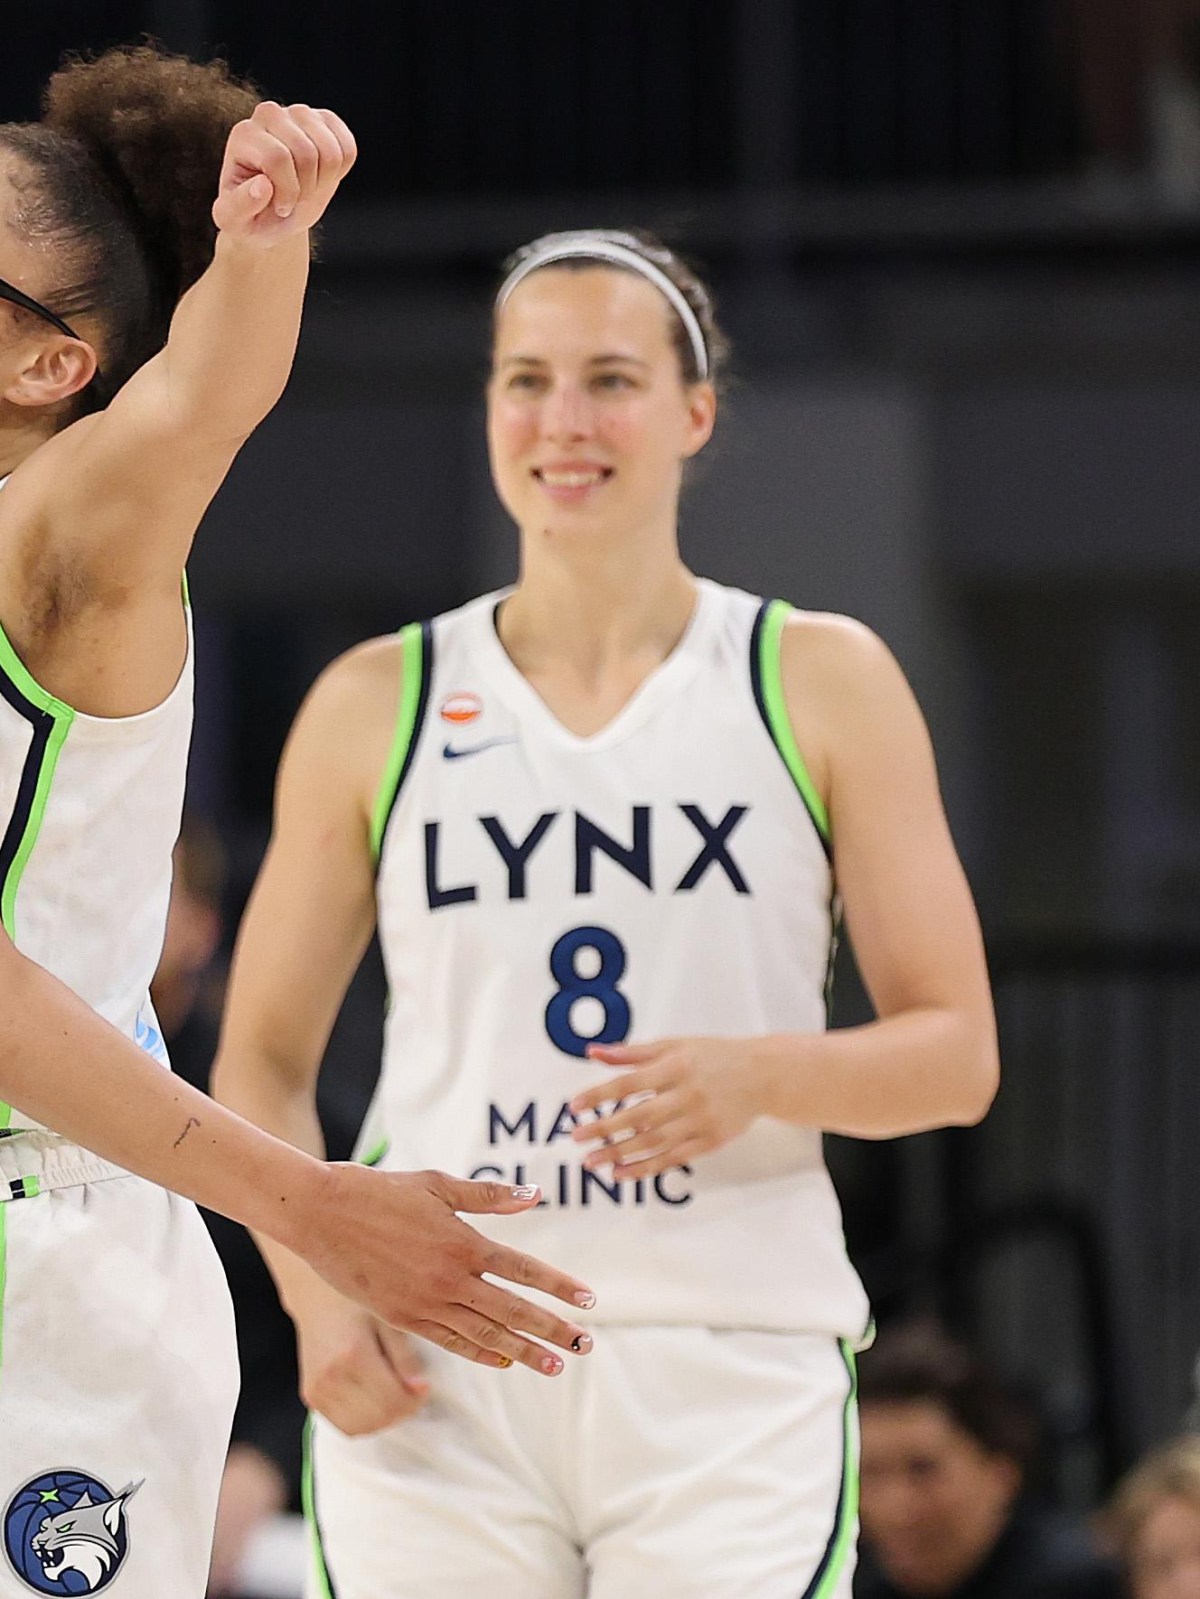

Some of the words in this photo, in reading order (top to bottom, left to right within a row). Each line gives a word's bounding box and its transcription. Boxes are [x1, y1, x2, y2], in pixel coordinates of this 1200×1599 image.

[423, 803, 752, 911] LYNX
[544, 925, 632, 1059] 8
[488, 1101, 648, 1145] MA
